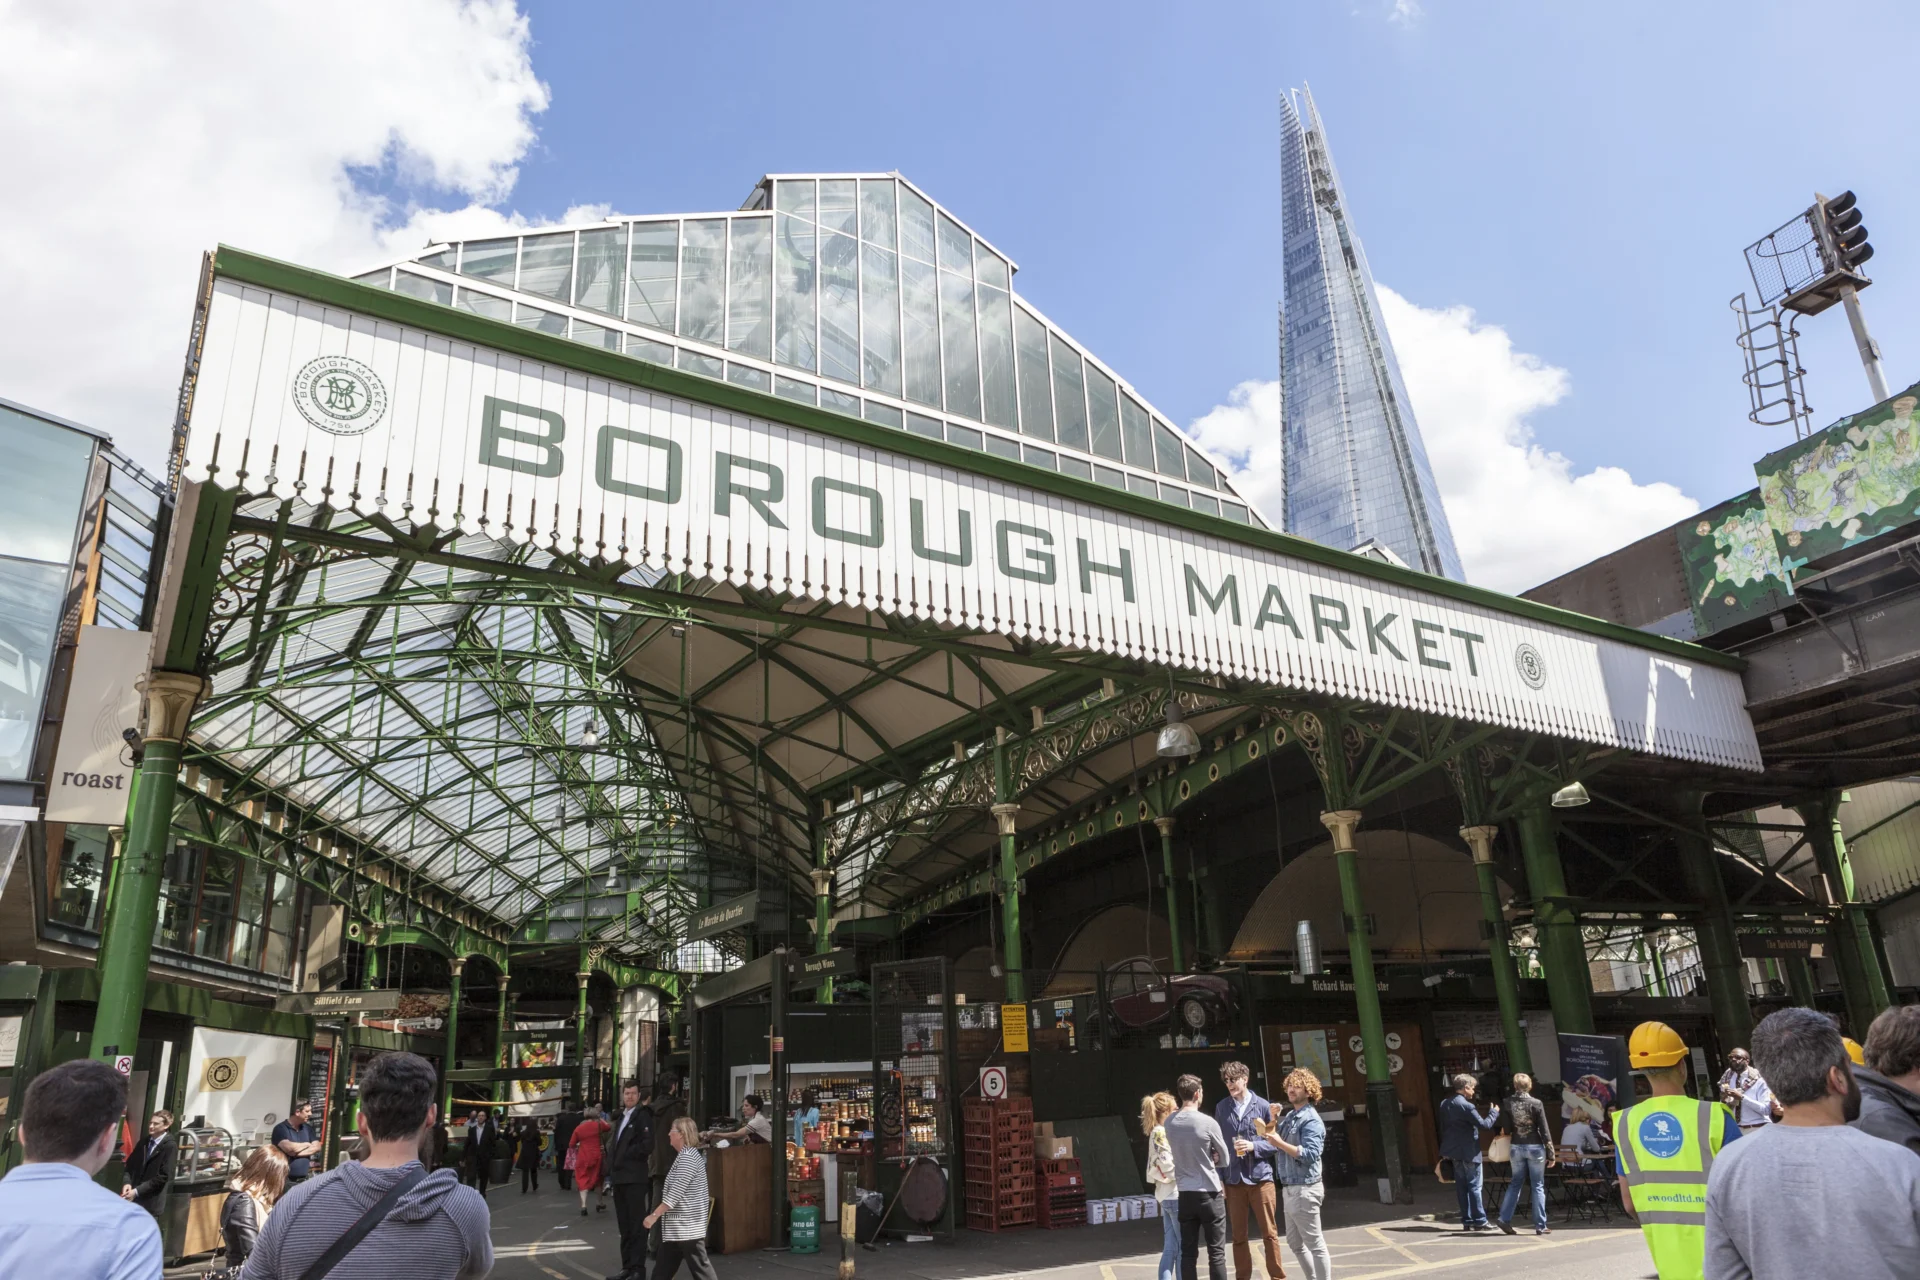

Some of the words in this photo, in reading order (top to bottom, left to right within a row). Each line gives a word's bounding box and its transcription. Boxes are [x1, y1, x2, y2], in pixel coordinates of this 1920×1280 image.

[300, 361, 349, 398] BOROUGH
[355, 367, 382, 414] MARKET
[324, 418, 351, 429] 1756
[478, 394, 1136, 603] BOROUGH
[1184, 562, 1484, 678] MARKET
[61, 769, 125, 790] roast
[61, 901, 86, 917] roast
[698, 918, 704, 930] Le
[704, 912, 720, 928] Marché
[719, 911, 725, 922] du
[725, 904, 744, 921] Quartier
[804, 960, 822, 972] Borough
[821, 958, 836, 969] Wines
[1312, 980, 1338, 991] Richard
[1340, 980, 1356, 992] Hawa
[1377, 981, 1389, 992] ster
[314, 996, 343, 1006] Sillfield
[344, 995, 362, 1005] Farm
[990, 1077, 997, 1090] 5
